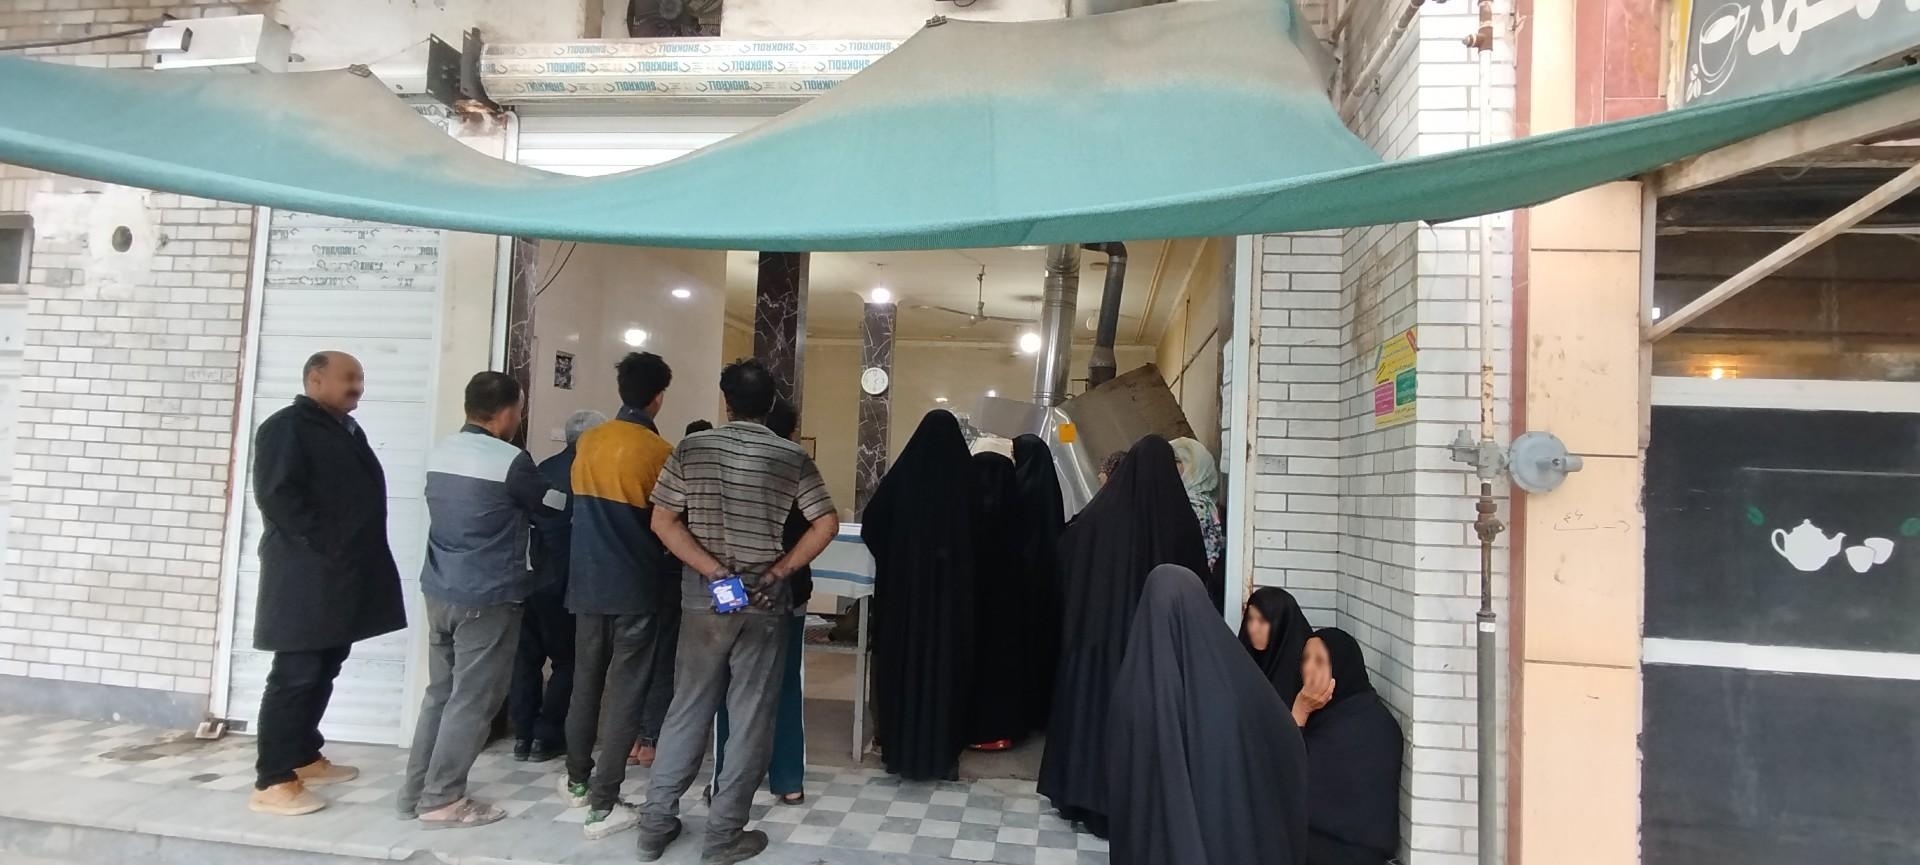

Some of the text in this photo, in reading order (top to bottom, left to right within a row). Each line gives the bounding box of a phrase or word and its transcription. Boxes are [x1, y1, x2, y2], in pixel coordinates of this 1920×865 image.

[566, 42, 892, 54] SHOKROLL SHOKROLL SHOKROLL SHOKROLL
[545, 60, 870, 73] SHOKROLL SHOKROLL SHOKROLL SHOKROLL
[526, 79, 843, 92] HOKROLL SHOKROLL SHOKROLL SHOKROLL
